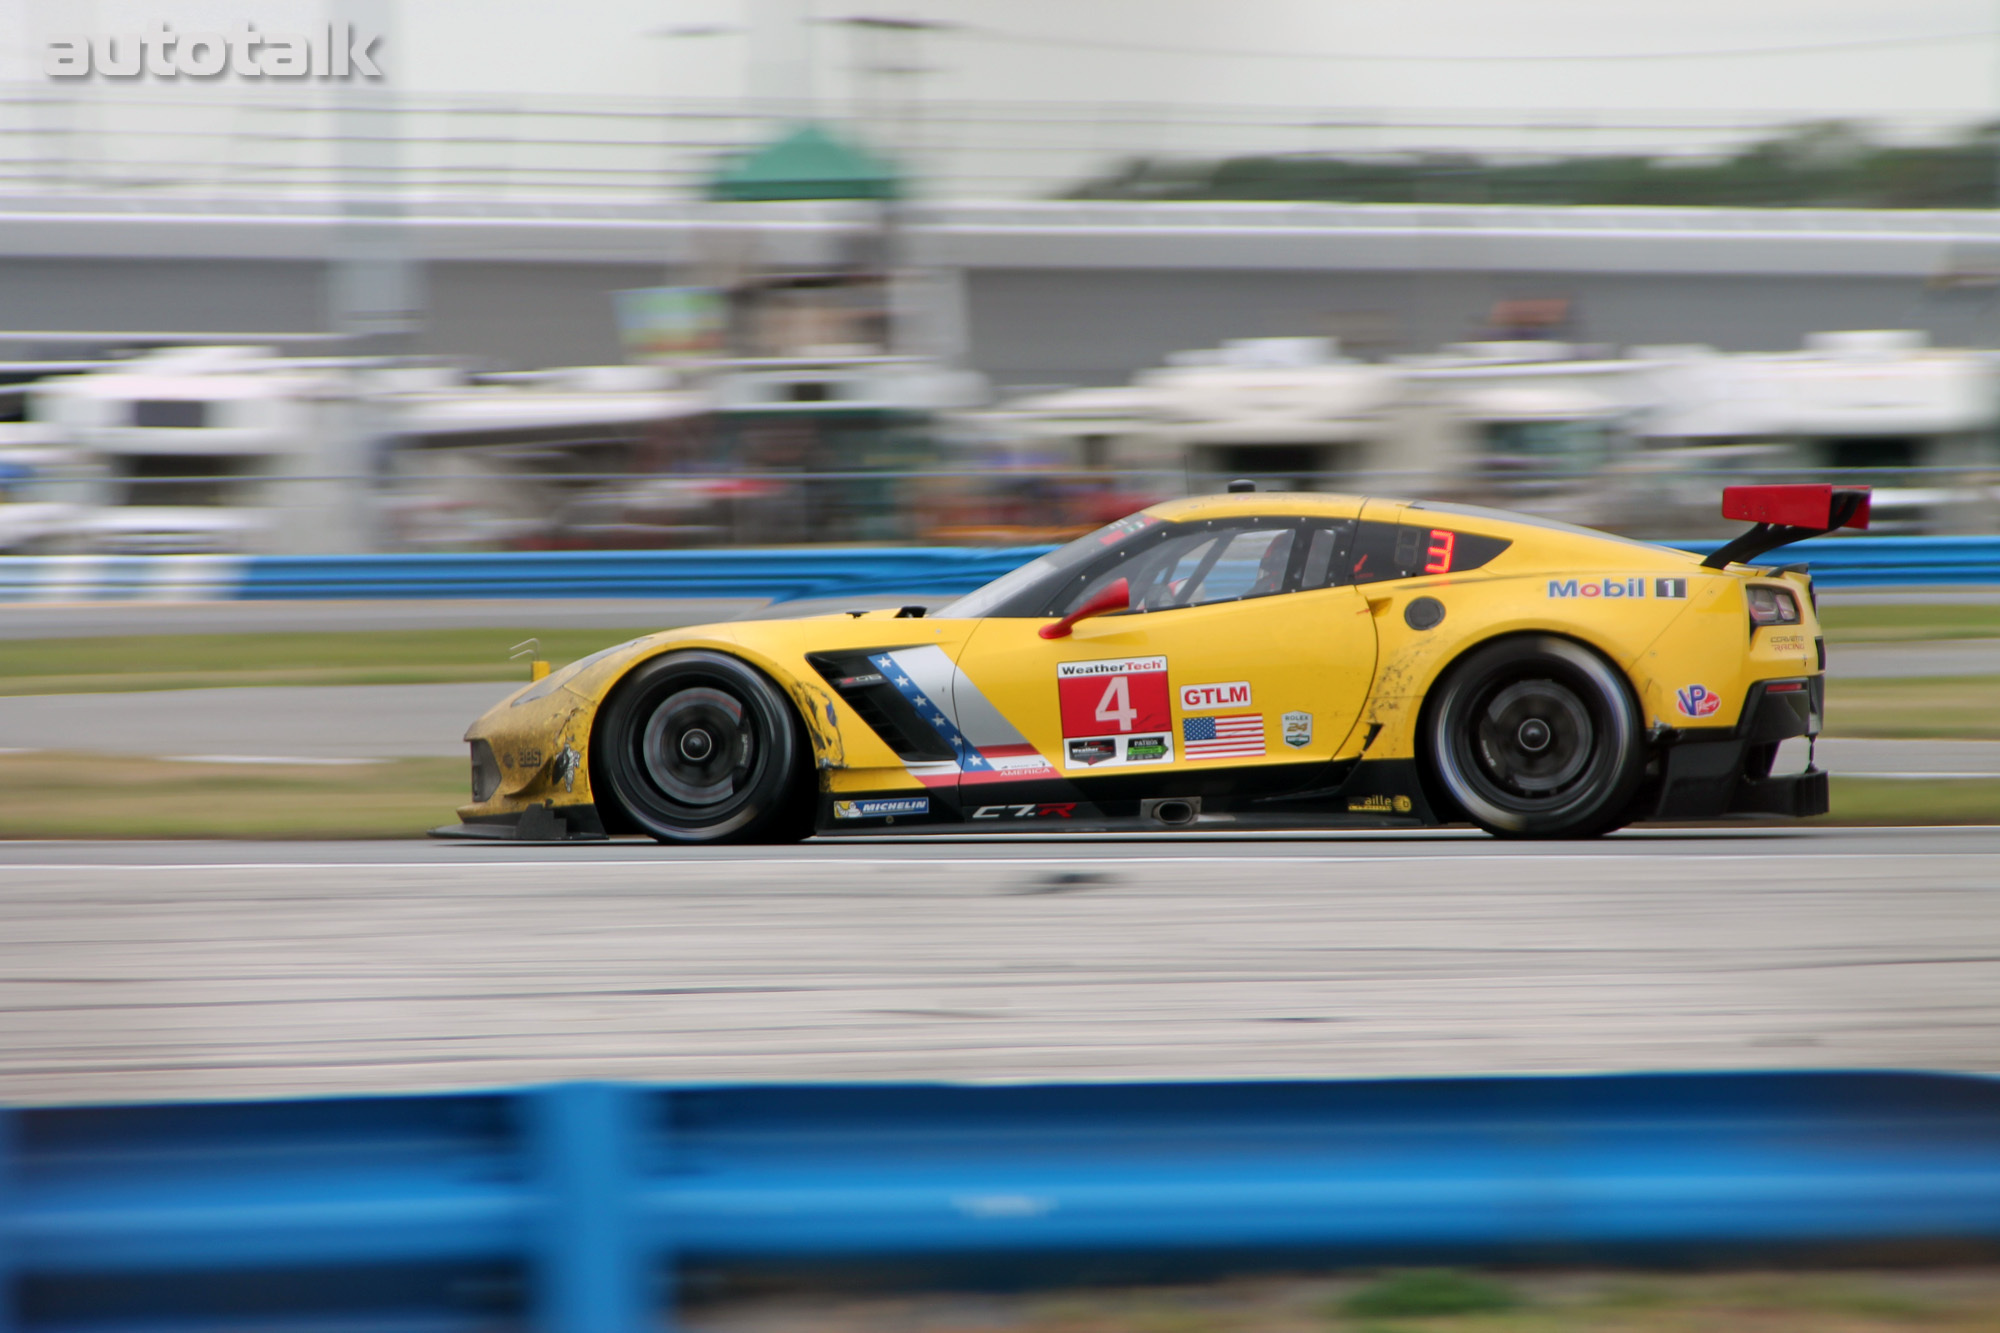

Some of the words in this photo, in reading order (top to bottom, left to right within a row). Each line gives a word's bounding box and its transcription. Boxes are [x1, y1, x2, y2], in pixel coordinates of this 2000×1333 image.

[1424, 529, 1455, 574] 3
[1548, 577, 1645, 599] Mobil
[1062, 659, 1161, 675] WeatherTech
[1094, 676, 1137, 732] 4
[1184, 685, 1248, 706] GTLM
[1677, 684, 1706, 717] VP
[1000, 767, 1051, 777] AMERICA
[862, 800, 926, 813] MICHELIN
[972, 802, 1077, 819] C7.R
